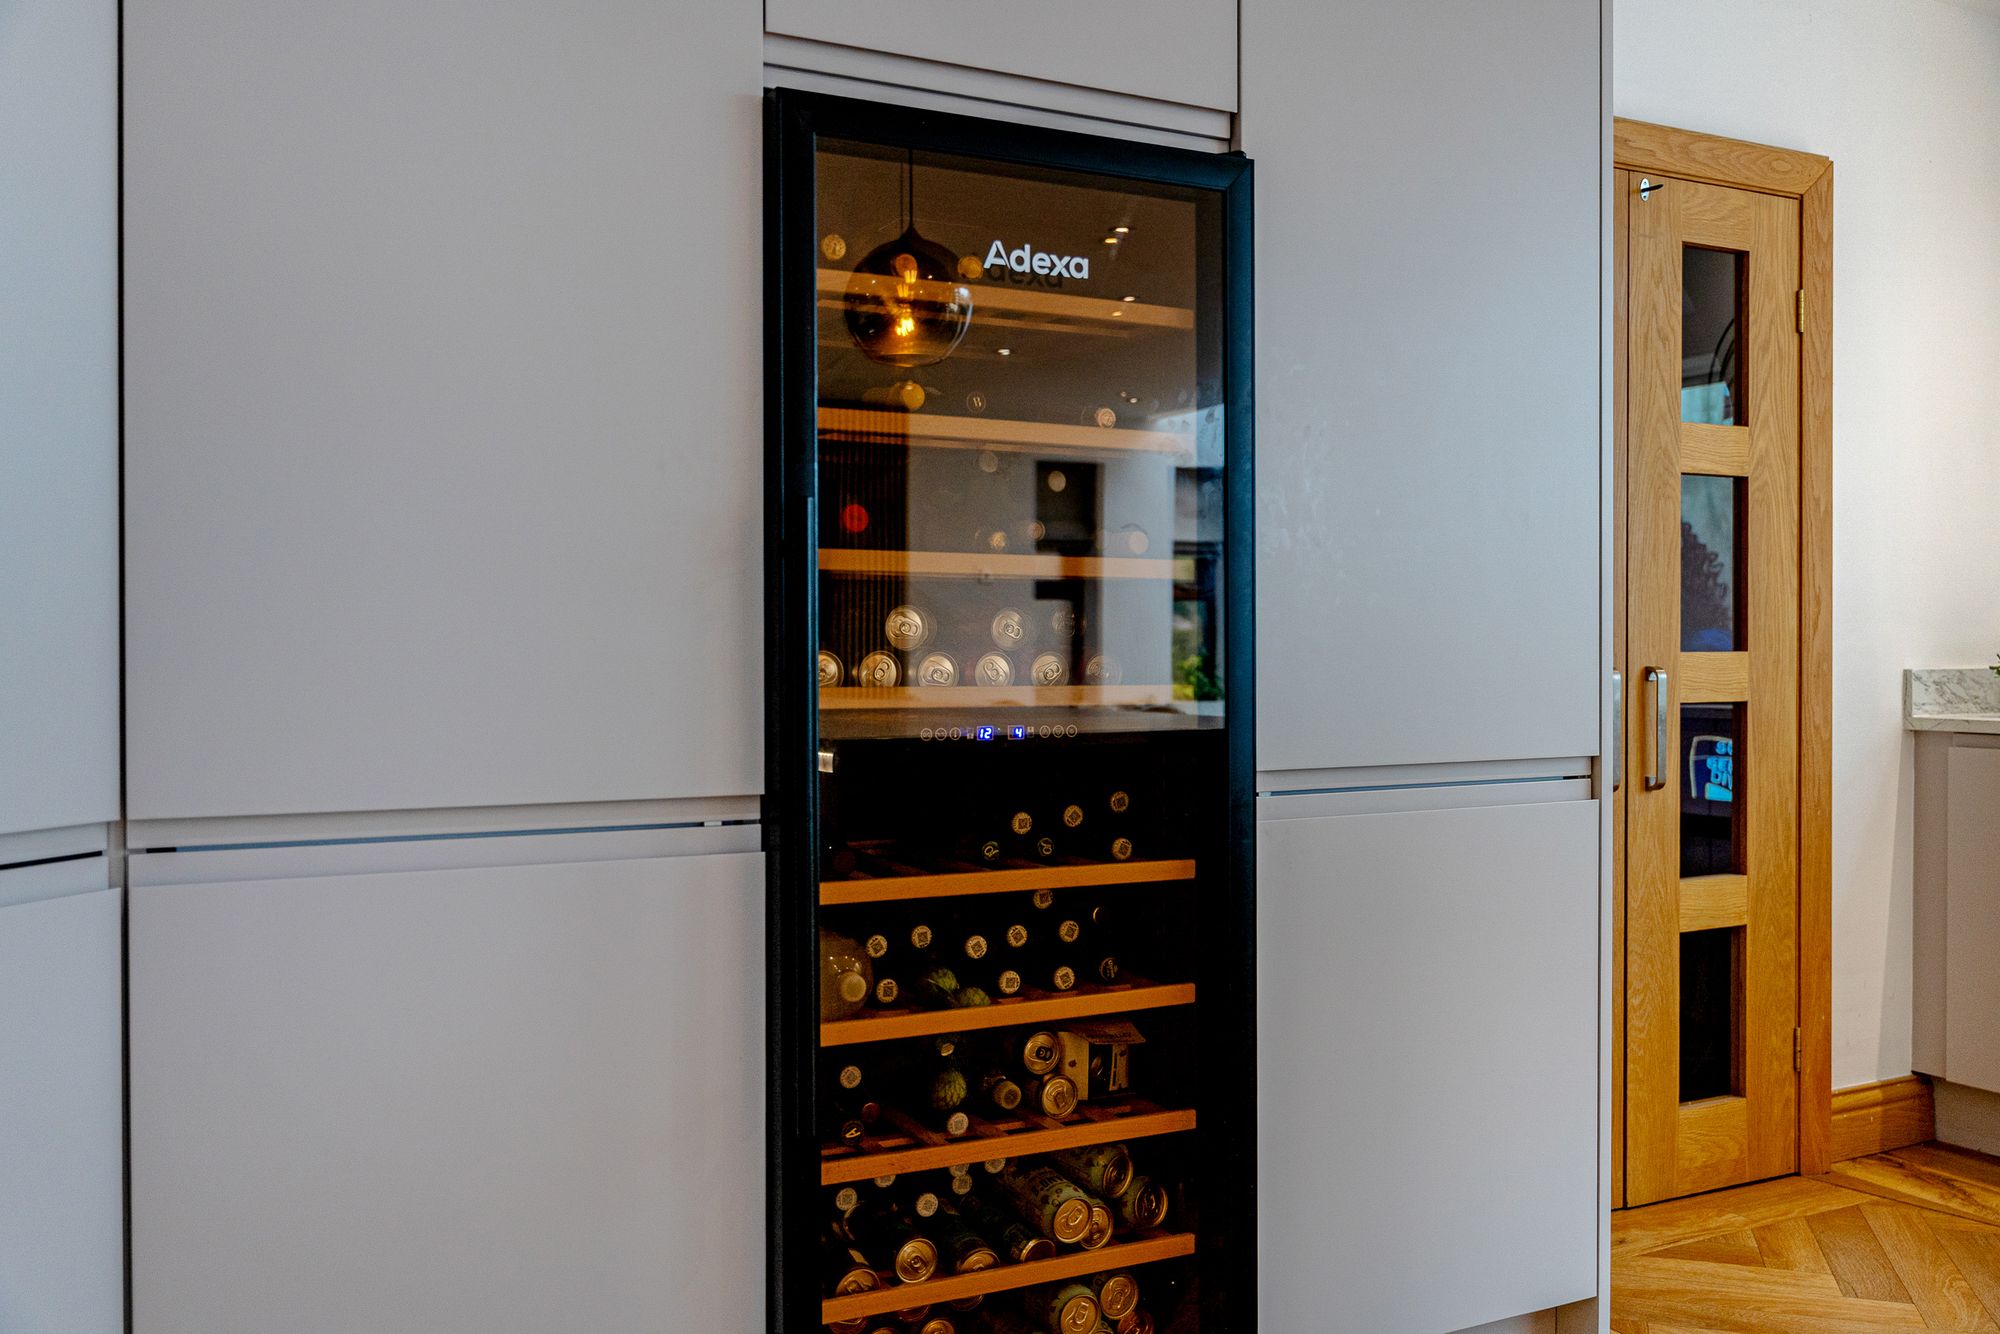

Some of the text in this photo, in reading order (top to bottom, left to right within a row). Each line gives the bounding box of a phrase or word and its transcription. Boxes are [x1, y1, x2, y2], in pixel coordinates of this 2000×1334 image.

[983, 239, 1090, 280] Adexa
[980, 728, 1023, 739] 12 4
